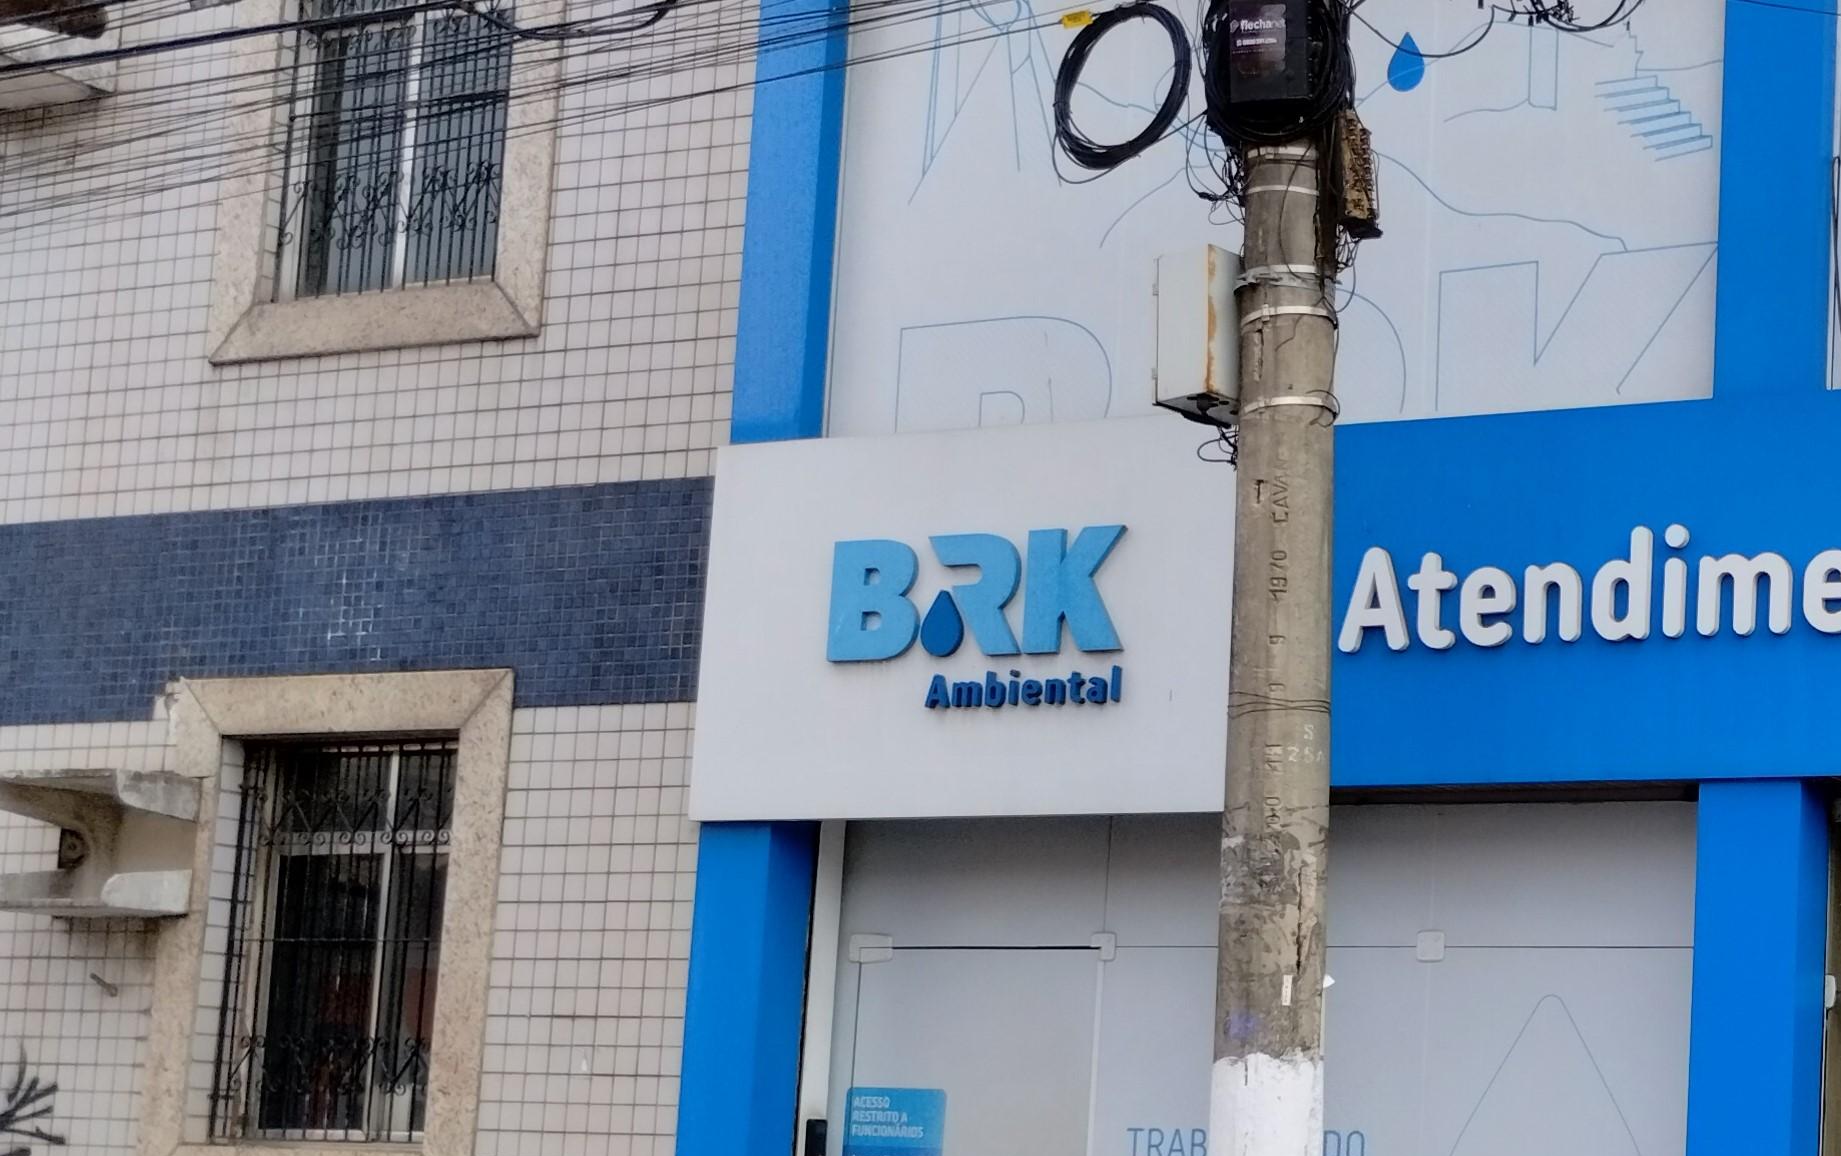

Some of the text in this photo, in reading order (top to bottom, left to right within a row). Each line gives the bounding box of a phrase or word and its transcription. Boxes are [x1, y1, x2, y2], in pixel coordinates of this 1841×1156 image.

[827, 524, 1129, 663] BRK
[924, 665, 1123, 710] Ambiental
[852, 1096, 890, 1108] ACESSO
[852, 1111, 908, 1123] RESTRITO A
[851, 1124, 924, 1138] FUNCIONÁRIOS
